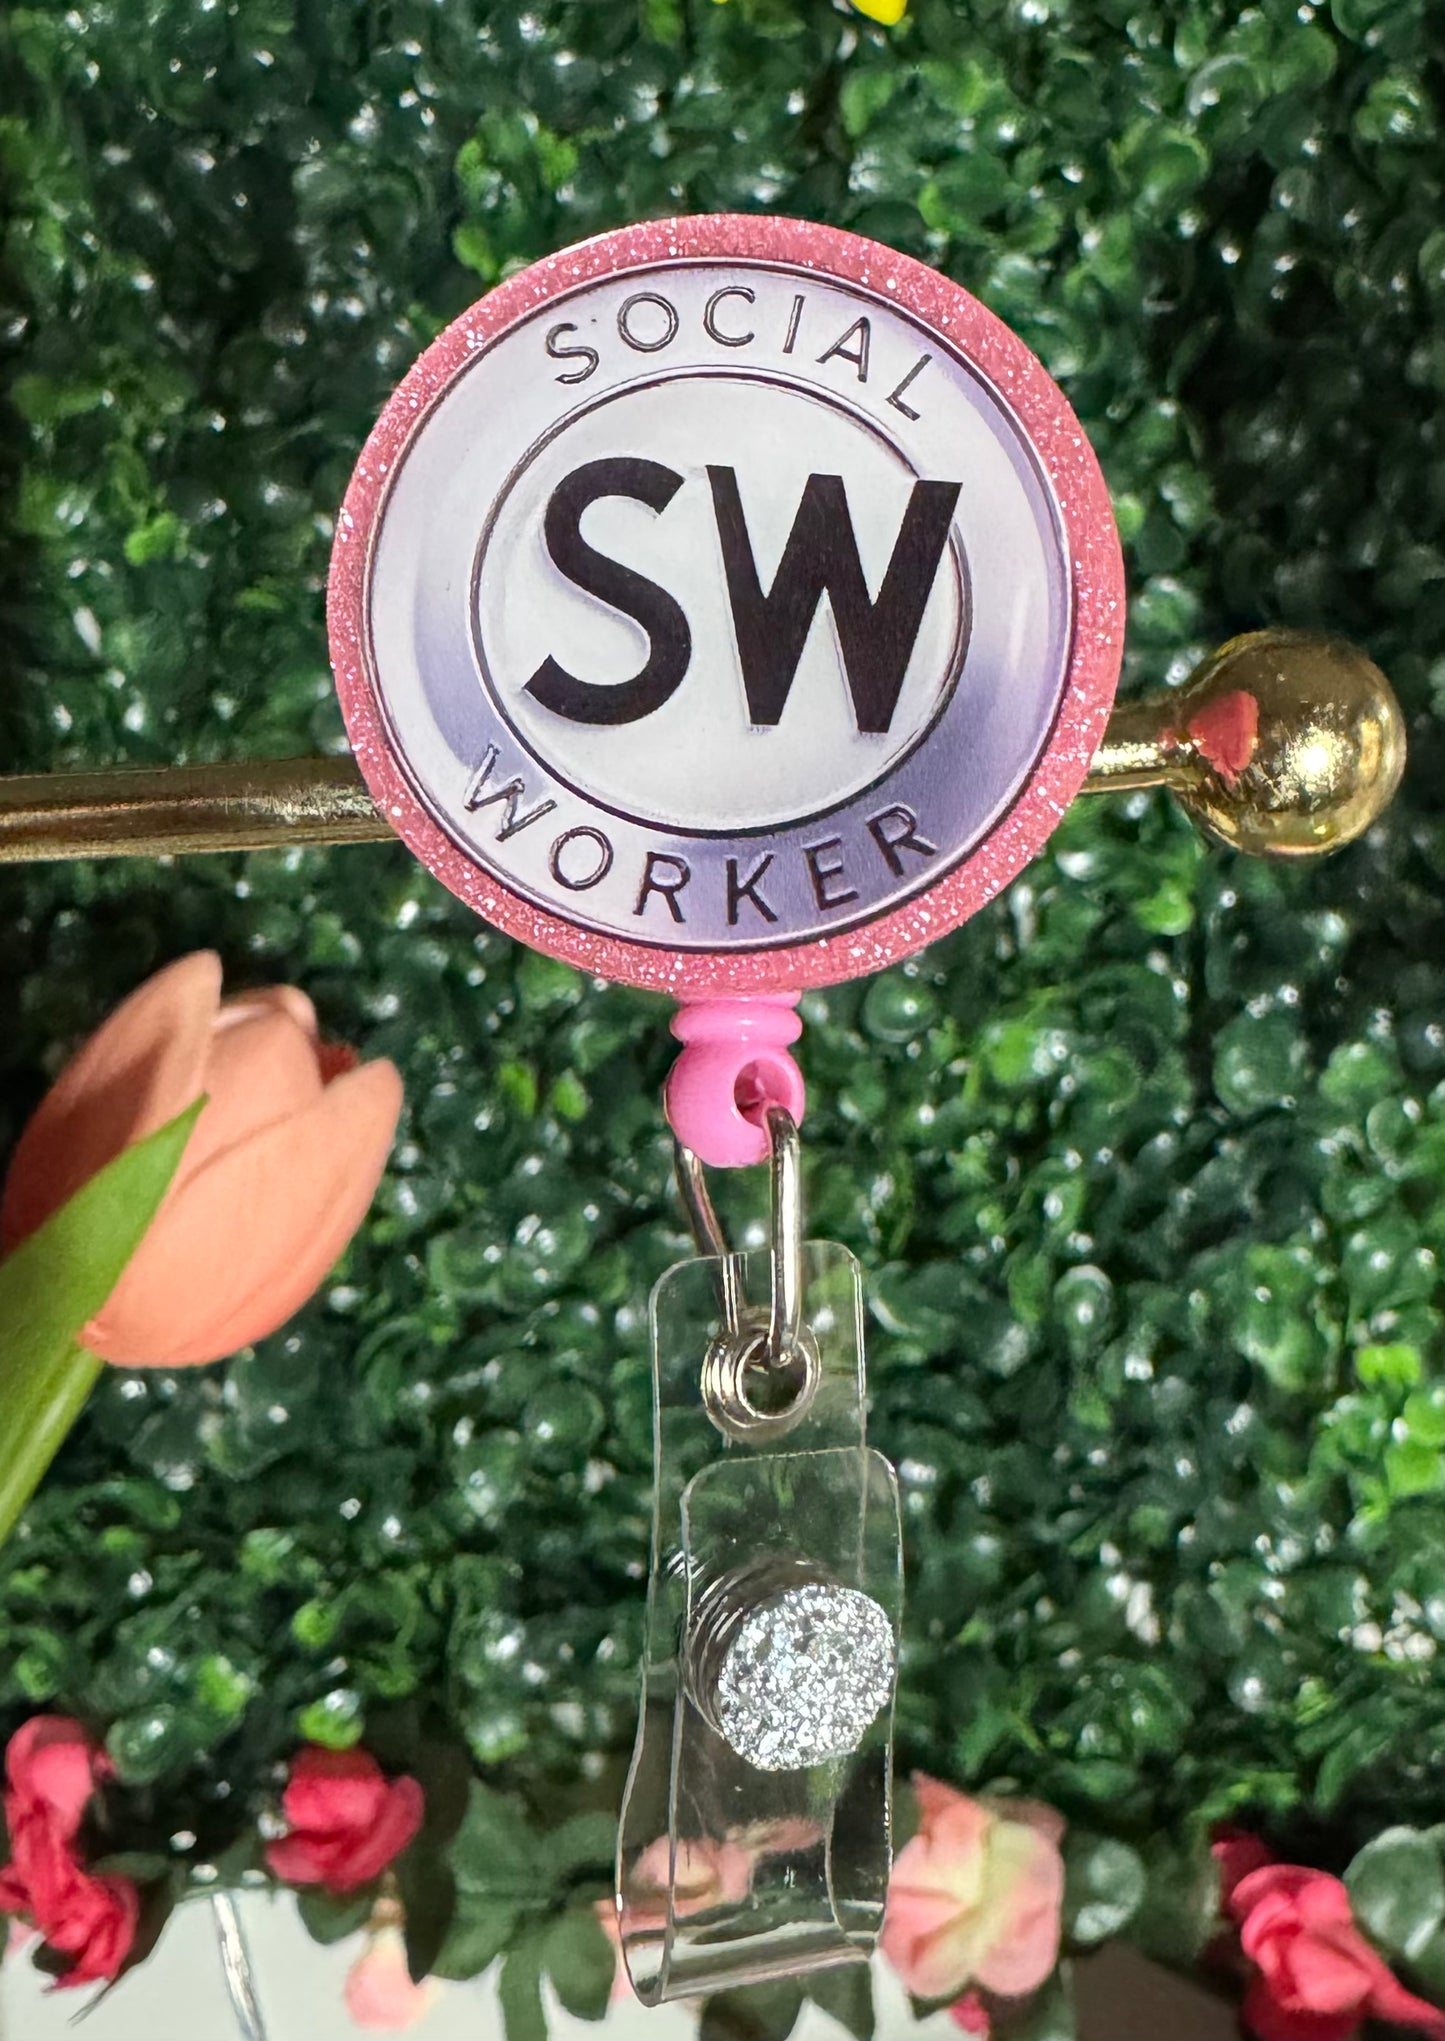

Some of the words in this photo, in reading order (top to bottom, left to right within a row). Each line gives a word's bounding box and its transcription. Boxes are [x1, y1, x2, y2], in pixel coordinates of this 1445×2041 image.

[546, 286, 934, 421] SOCIAL
[523, 457, 963, 733] SW
[465, 745, 938, 926] WORKER
